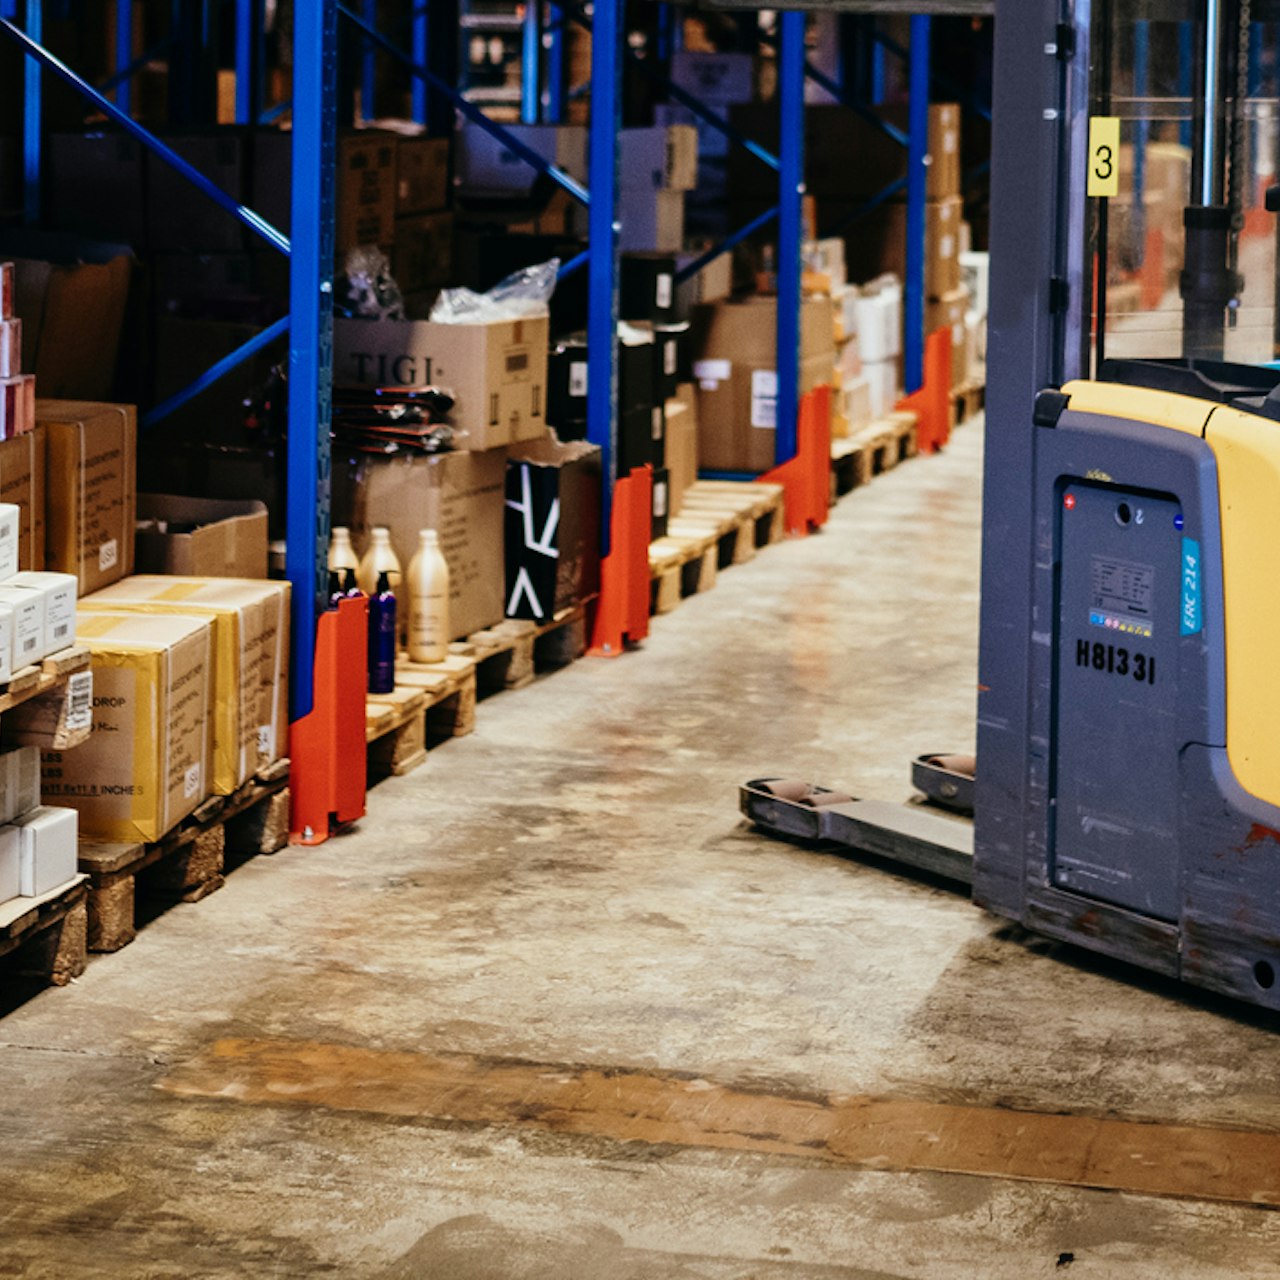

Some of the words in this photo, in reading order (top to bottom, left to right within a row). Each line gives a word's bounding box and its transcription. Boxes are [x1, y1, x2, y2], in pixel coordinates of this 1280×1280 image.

[1094, 144, 1113, 180] 3
[351, 352, 433, 386] TIGI
[1183, 553, 1197, 591] 214
[1183, 592, 1197, 630] ERC
[1075, 639, 1155, 686] H81331
[100, 785, 144, 796] INCHES
